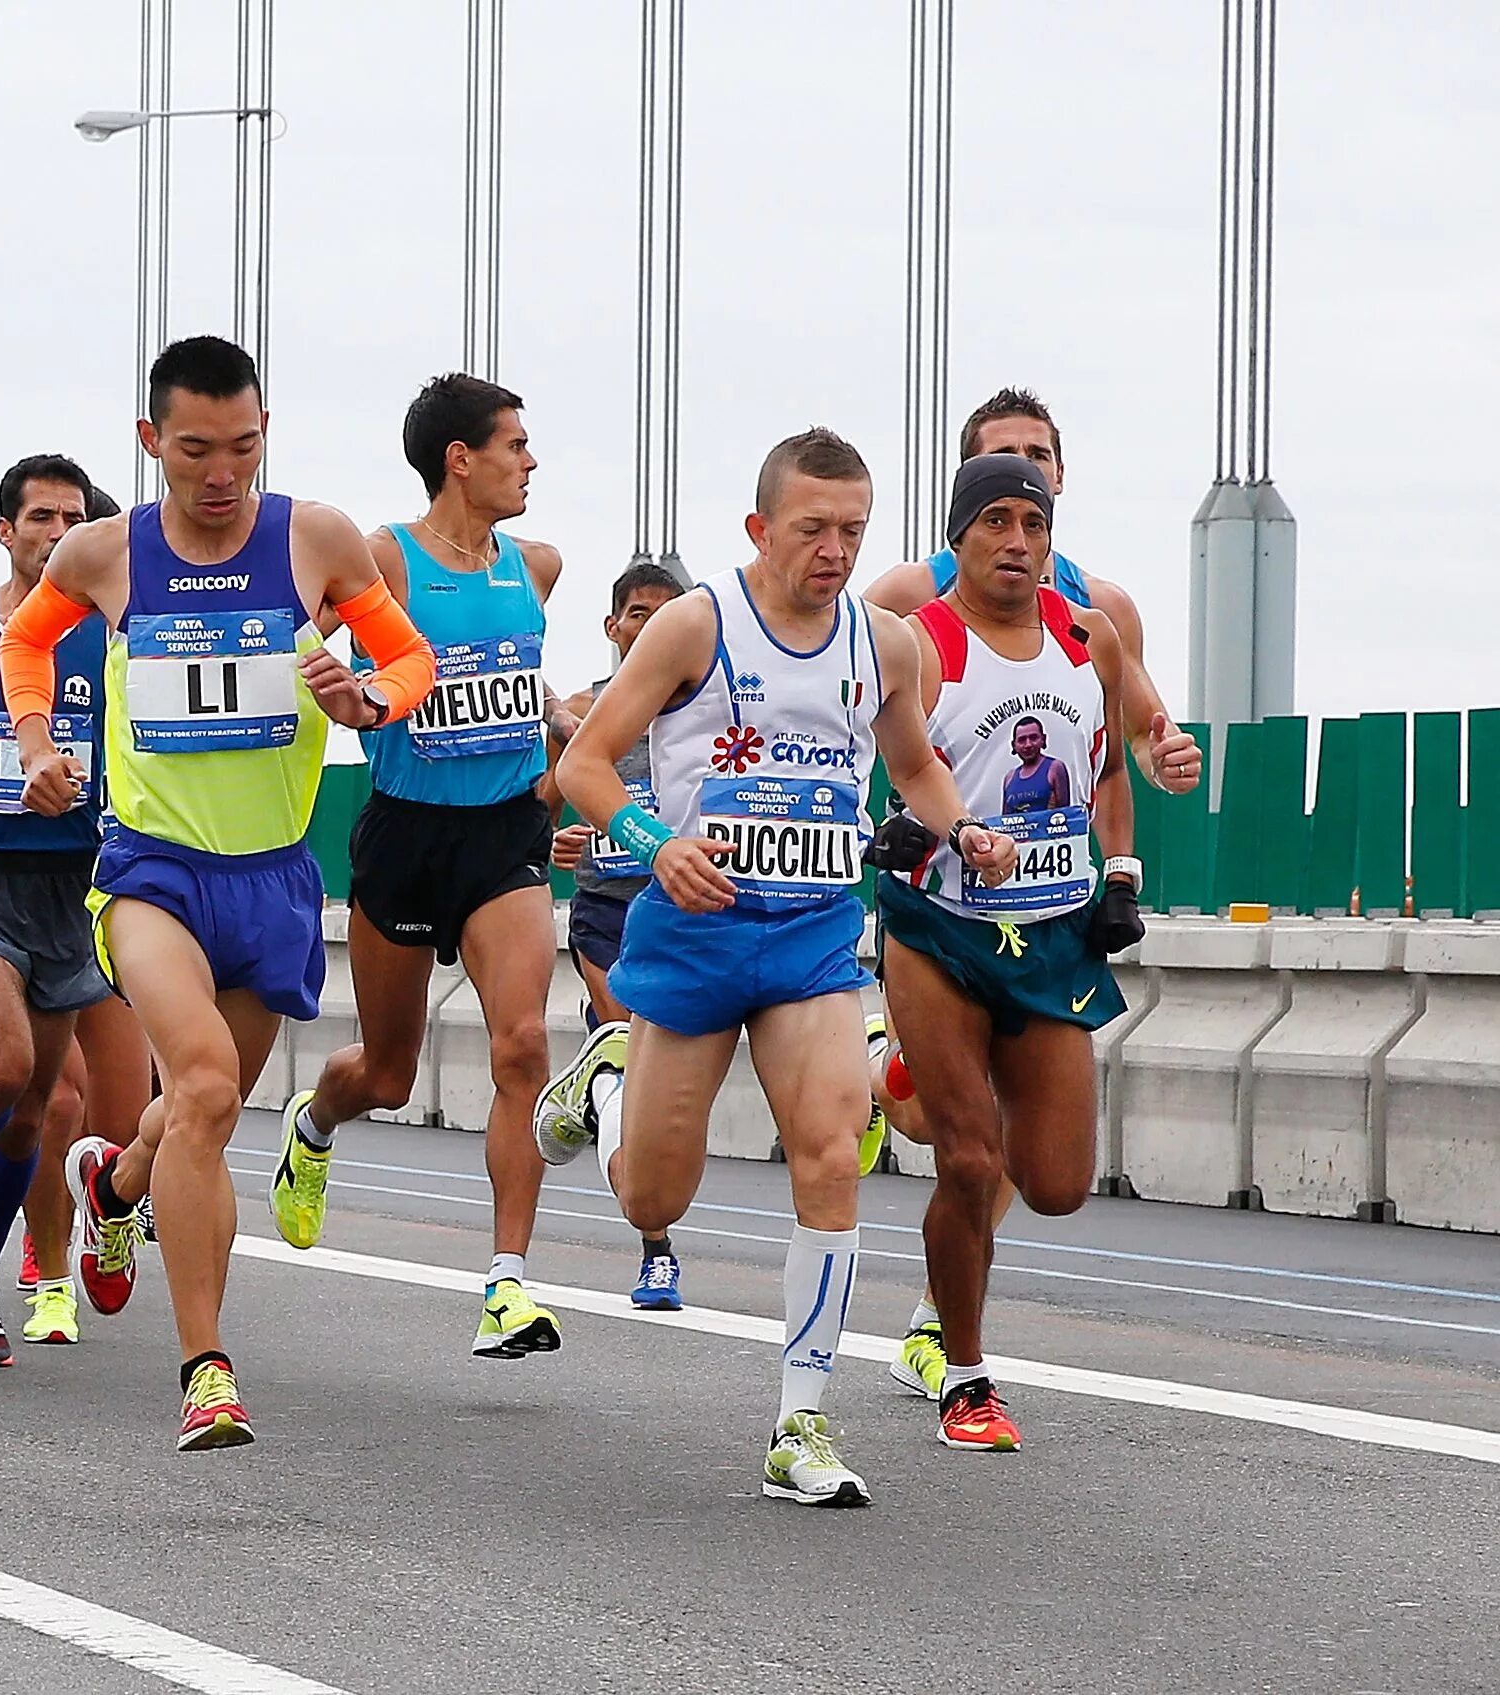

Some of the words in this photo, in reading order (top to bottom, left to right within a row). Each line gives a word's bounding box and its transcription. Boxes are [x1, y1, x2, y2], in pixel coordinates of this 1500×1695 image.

[169, 574, 250, 593] saucony
[173, 619, 204, 630] TATA
[155, 630, 225, 641] CONSULTANCY
[167, 641, 212, 652] SERVICES
[238, 637, 269, 648] TATA
[446, 645, 471, 655] TATA
[496, 656, 521, 666] TATA
[442, 663, 478, 675] SERVICES
[187, 662, 238, 714] LI
[63, 693, 91, 706] mico
[415, 674, 539, 729] MEUCCI
[733, 691, 765, 702] errea
[974, 723, 993, 740] EN
[985, 697, 1025, 730] MEMORIA
[1024, 694, 1032, 710] A
[1032, 692, 1050, 710] JOSE
[1051, 695, 1082, 727] MALAGA
[52, 730, 73, 738] TATA
[143, 730, 157, 738] TCS
[173, 730, 191, 738] YORK
[207, 728, 245, 737] MARATHON
[772, 732, 817, 744] ATLETICA
[771, 742, 857, 769] casone
[756, 781, 783, 792] TATA
[736, 791, 801, 804] CONSULTANCY
[748, 803, 789, 815] SERVICES
[811, 805, 834, 816] TATA
[1001, 816, 1025, 825] TATA
[1046, 825, 1068, 834] TATA
[707, 823, 854, 879] BUCCILLI
[395, 923, 432, 932] ESERCITO
